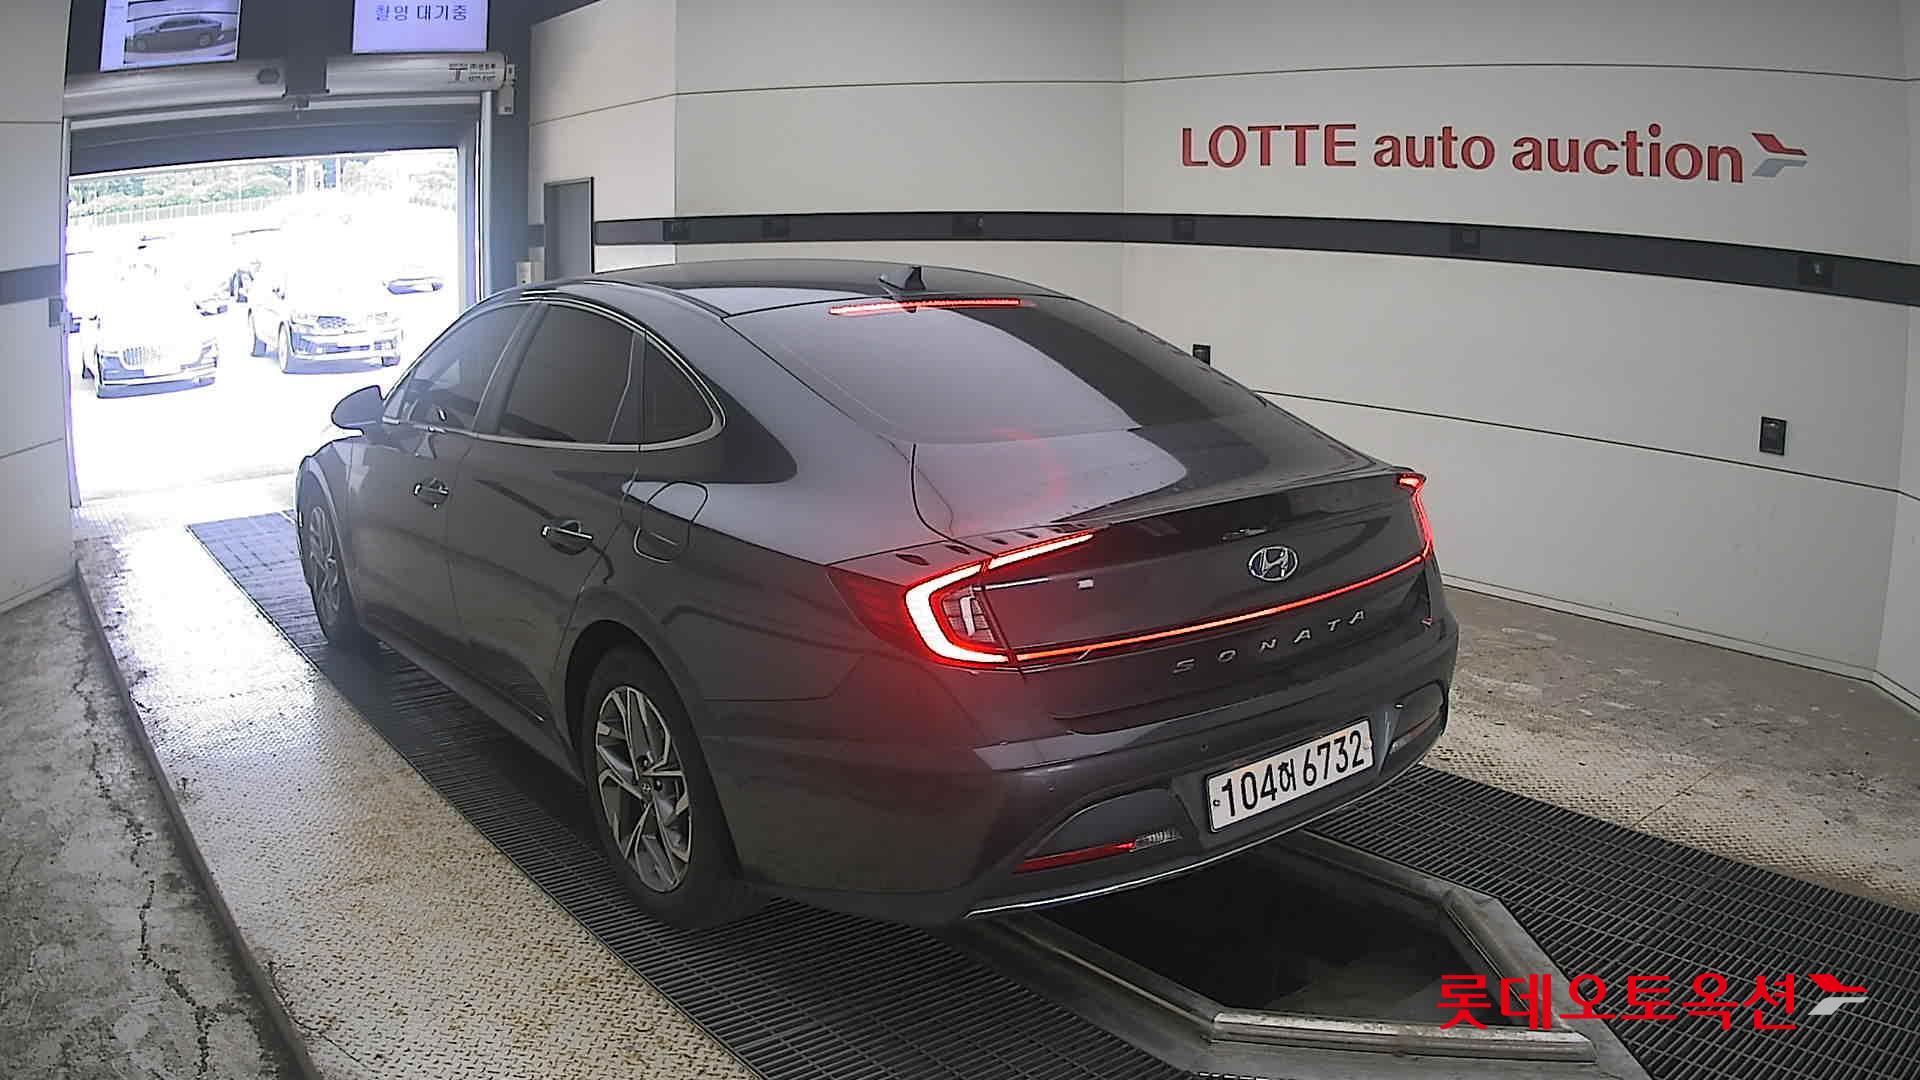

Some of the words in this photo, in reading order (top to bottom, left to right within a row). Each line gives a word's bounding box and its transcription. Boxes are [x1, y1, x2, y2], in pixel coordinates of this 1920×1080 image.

[416, 4, 467, 21] 대기중
[1182, 123, 1357, 167] LOTTE
[1373, 126, 1495, 170] auto
[1512, 123, 1744, 183] auction
[1172, 609, 1367, 673] SONATA
